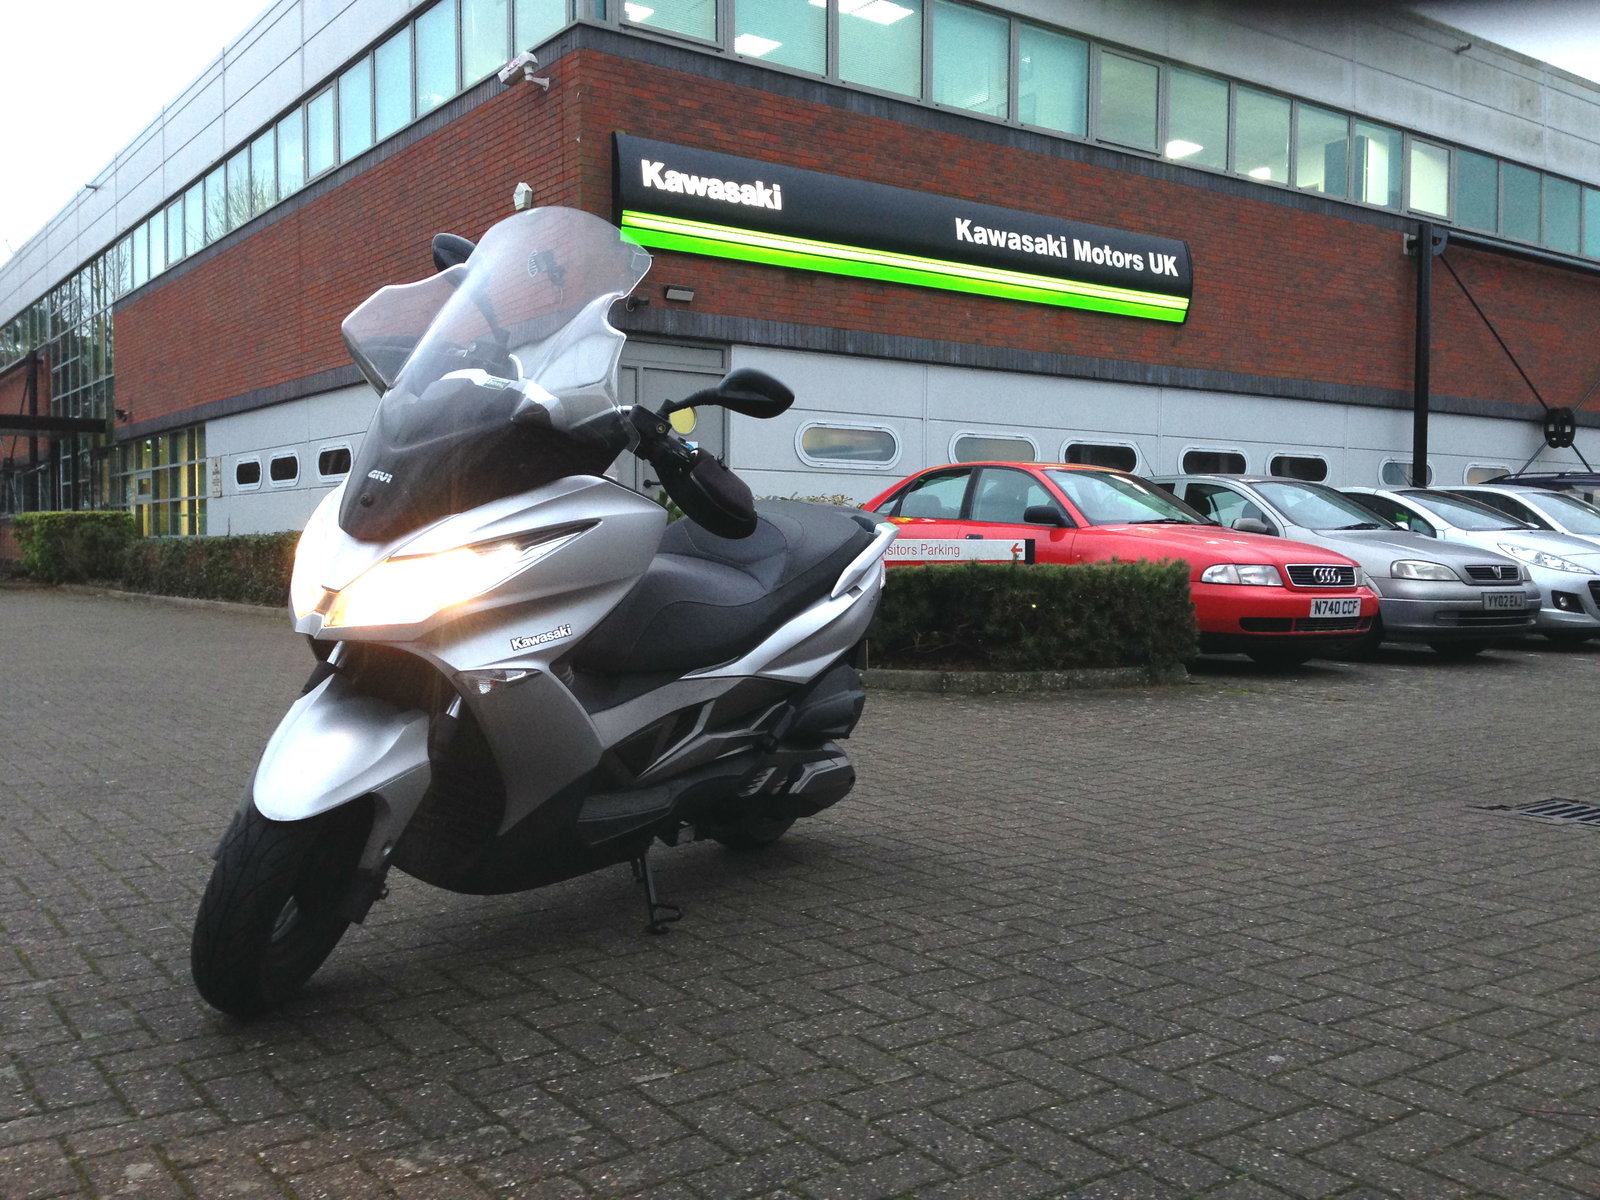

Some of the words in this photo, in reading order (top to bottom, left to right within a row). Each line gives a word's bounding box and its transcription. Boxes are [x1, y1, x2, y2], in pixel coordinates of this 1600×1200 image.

[641, 159, 782, 210] Kawasaki
[955, 217, 1067, 258] Kawasaki
[1073, 239, 1144, 271] Motors
[1149, 252, 1179, 277] UK
[920, 544, 960, 557] Parking
[1314, 601, 1340, 614] N740
[1342, 600, 1358, 614] CCF
[510, 624, 573, 651] Kawasaki
